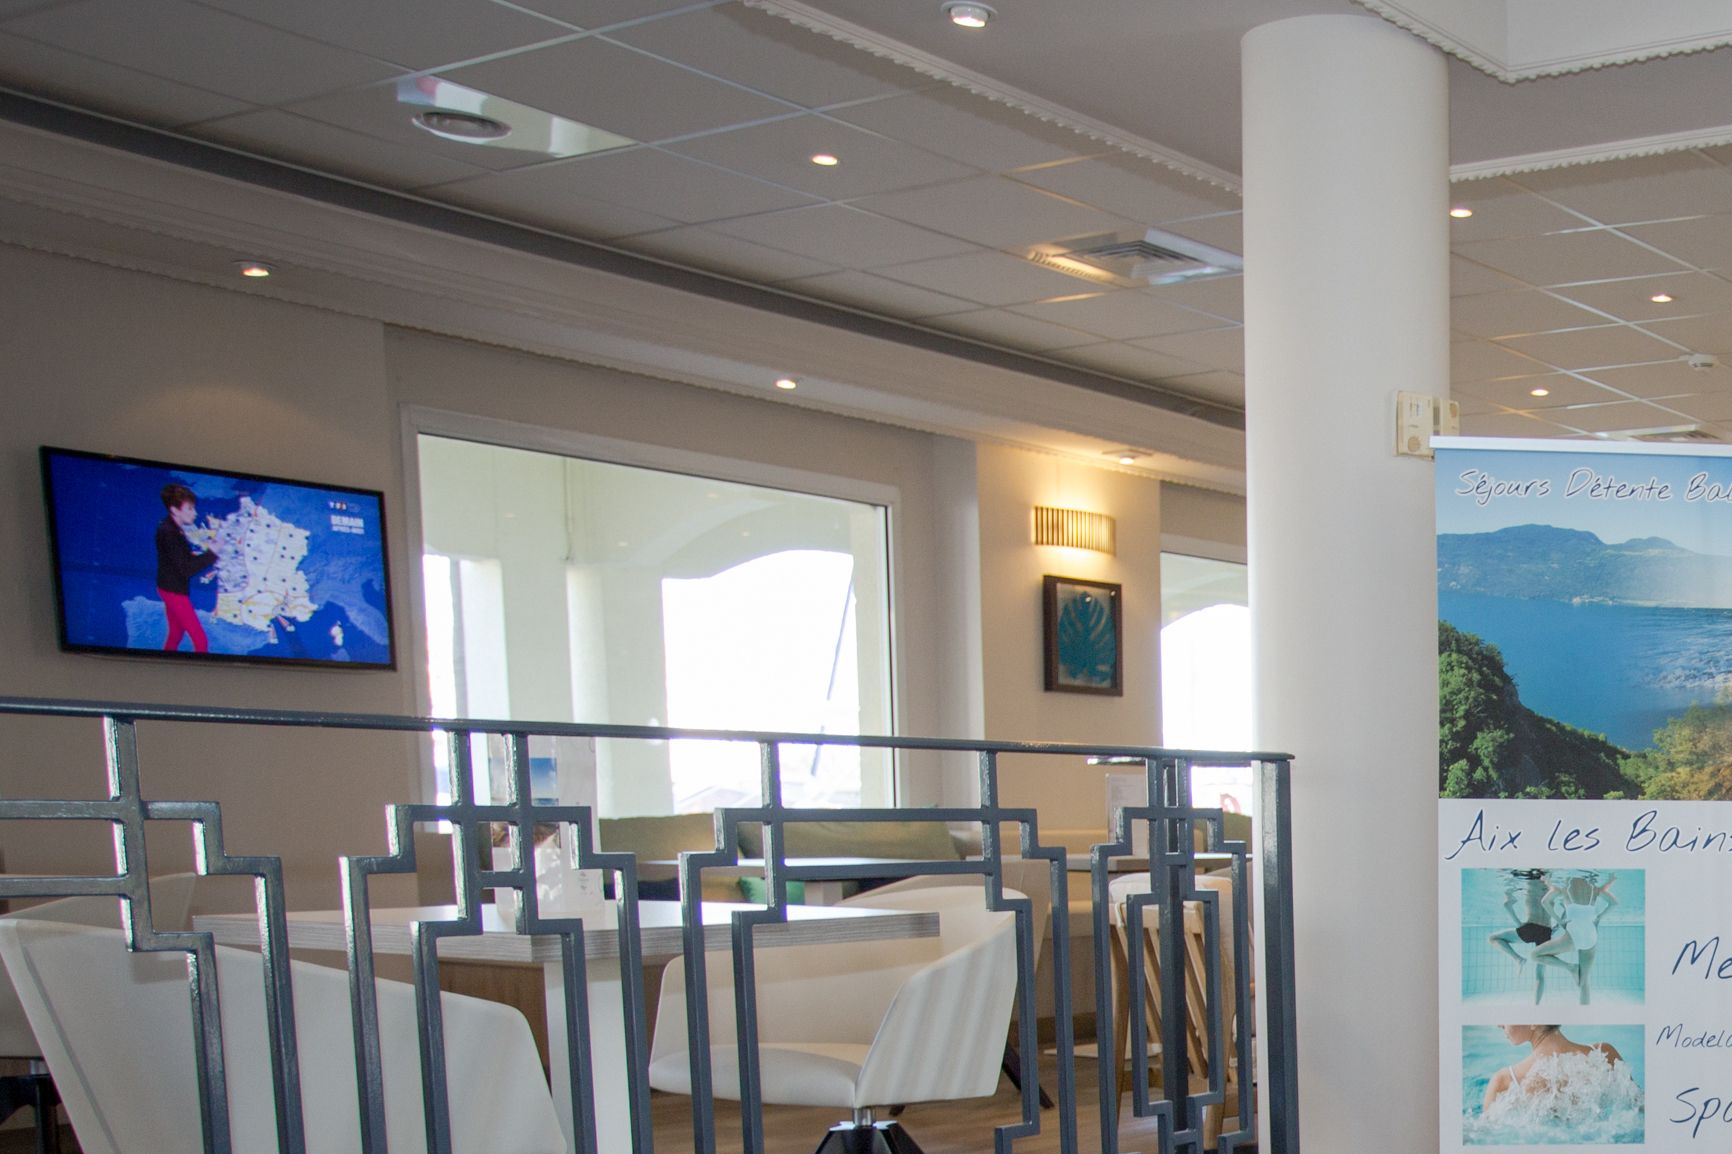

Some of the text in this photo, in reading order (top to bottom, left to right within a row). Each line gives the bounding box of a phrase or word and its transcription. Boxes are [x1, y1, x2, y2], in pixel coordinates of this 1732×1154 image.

[1456, 469, 1550, 505] Séjours
[1565, 467, 1672, 500] Détente
[1443, 808, 1522, 861] Aix
[1547, 819, 1601, 852] les
